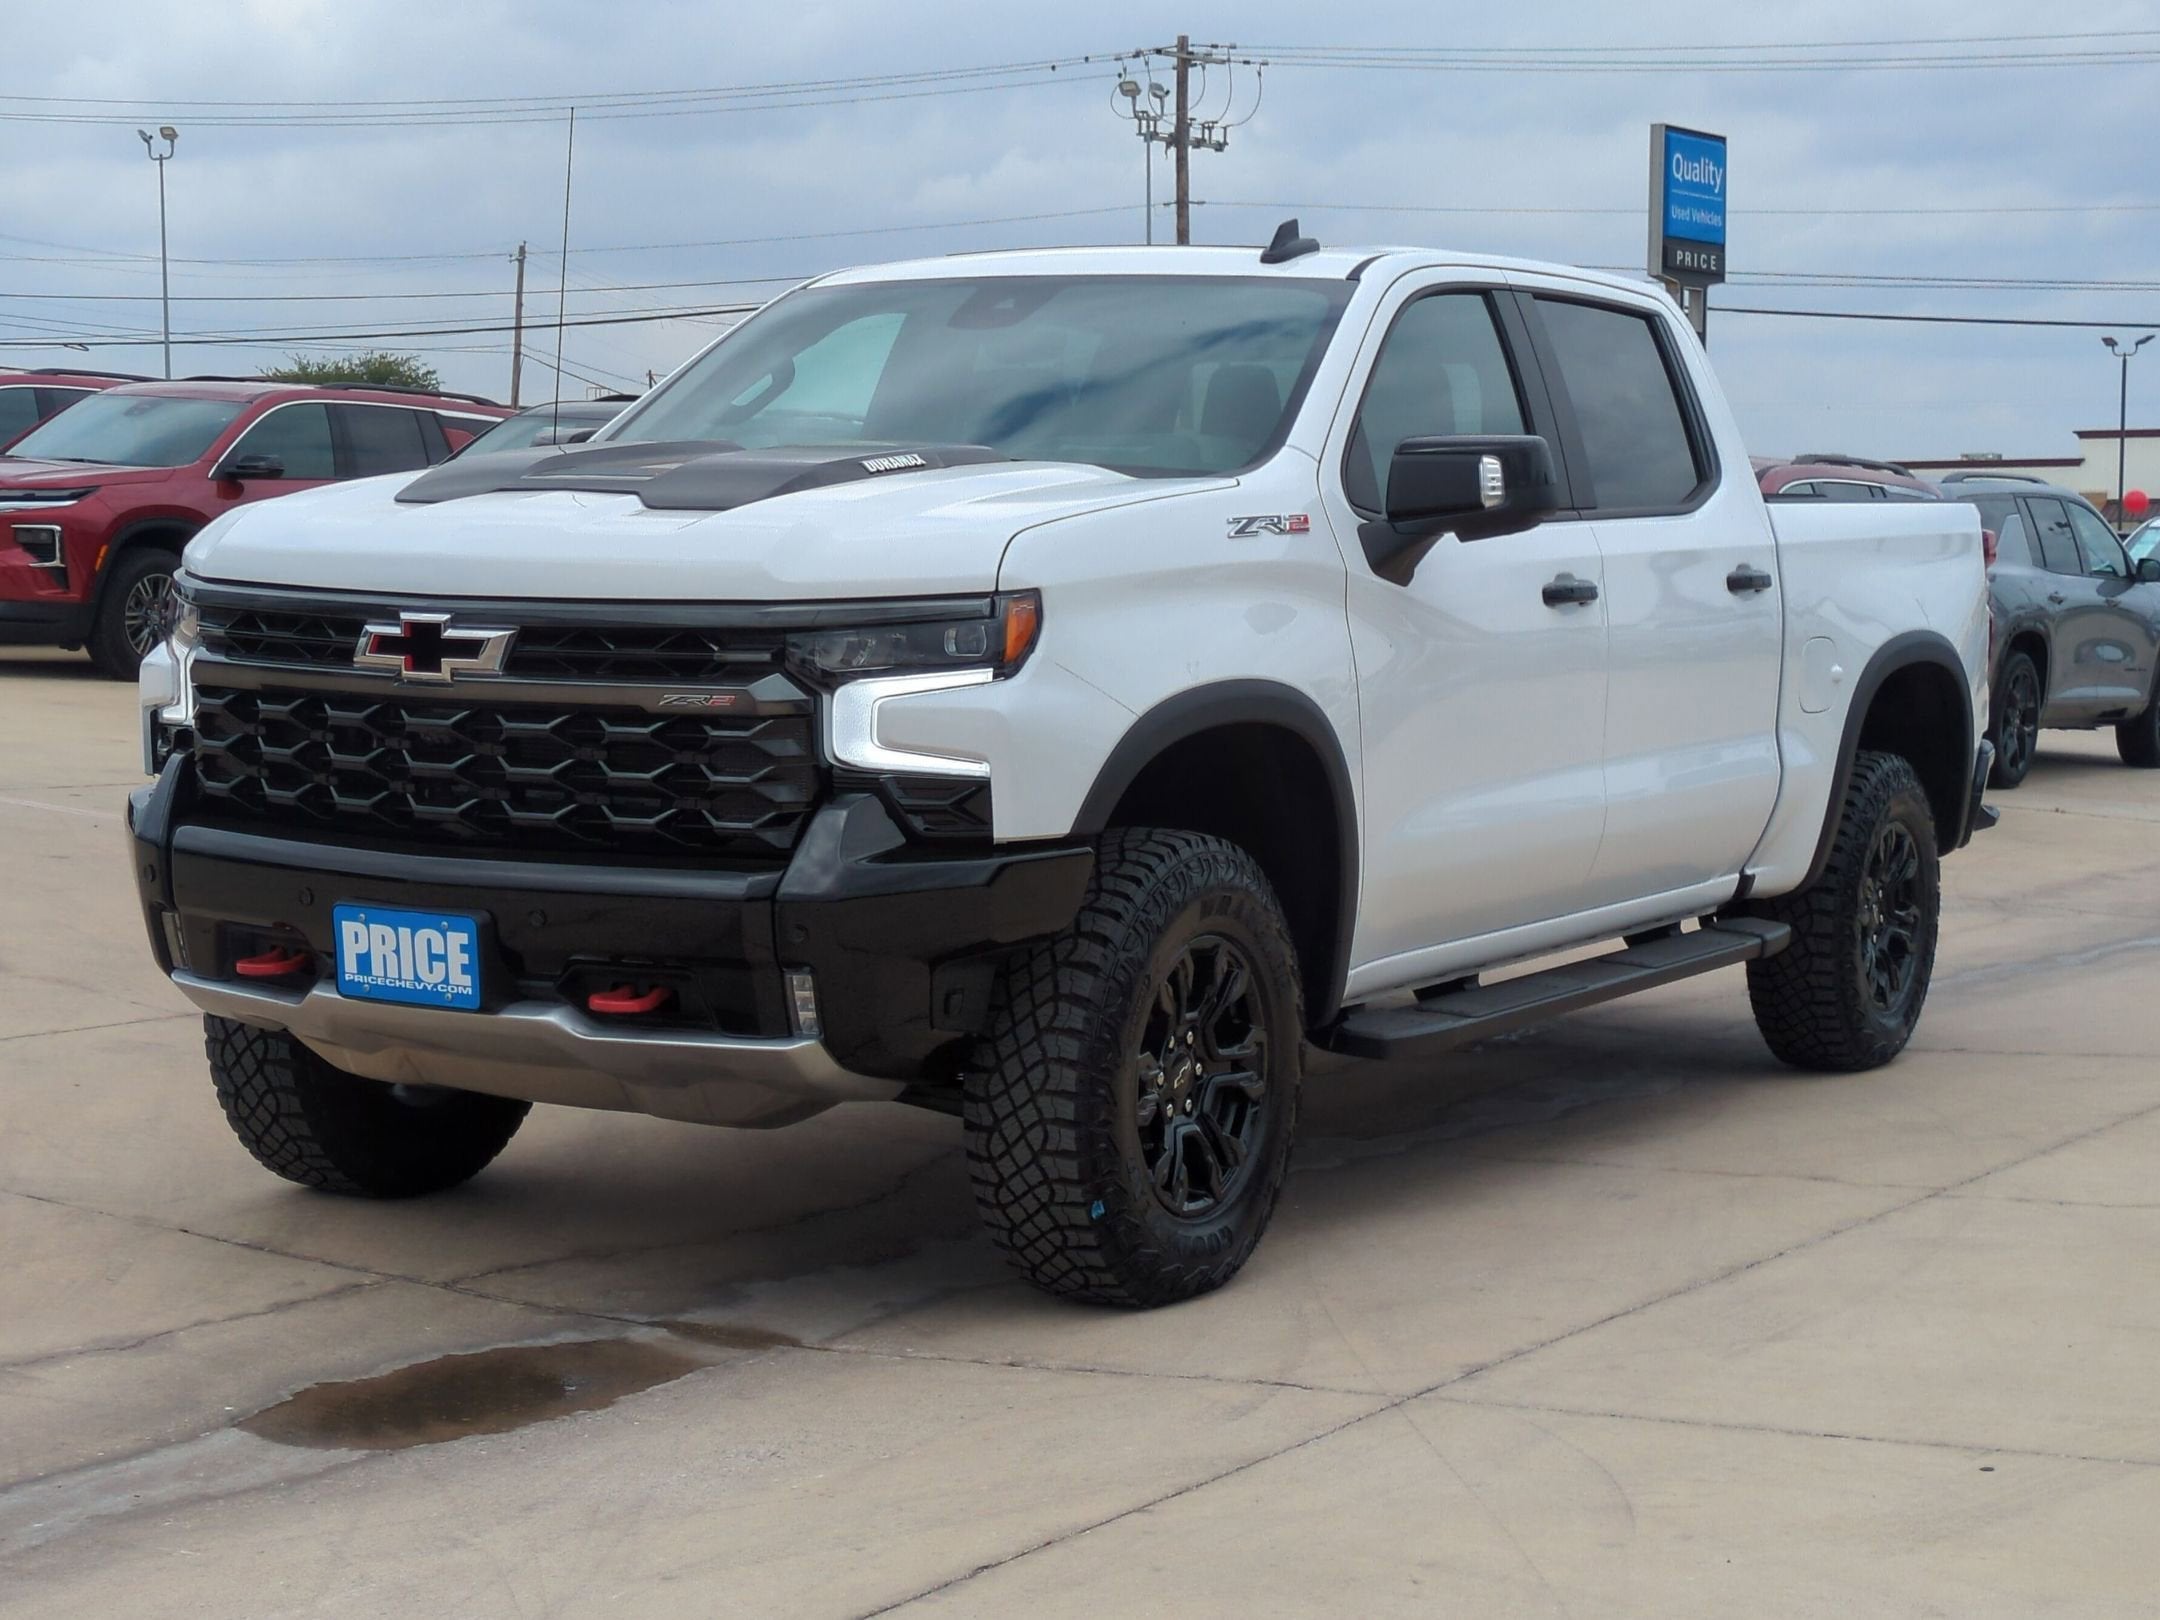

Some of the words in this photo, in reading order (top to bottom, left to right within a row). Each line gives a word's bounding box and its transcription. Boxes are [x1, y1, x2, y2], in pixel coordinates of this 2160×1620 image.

[1672, 153, 1723, 193] Quality
[1671, 205, 1690, 222] Used
[1692, 207, 1722, 227] Vehicles
[1676, 250, 1717, 271] PRICE
[861, 453, 927, 473] DURAMAX
[1226, 513, 1310, 539] ZR2
[658, 694, 736, 706] ZR2
[341, 920, 472, 986] PRICE
[345, 973, 473, 995] PRICECHEVY.COM
